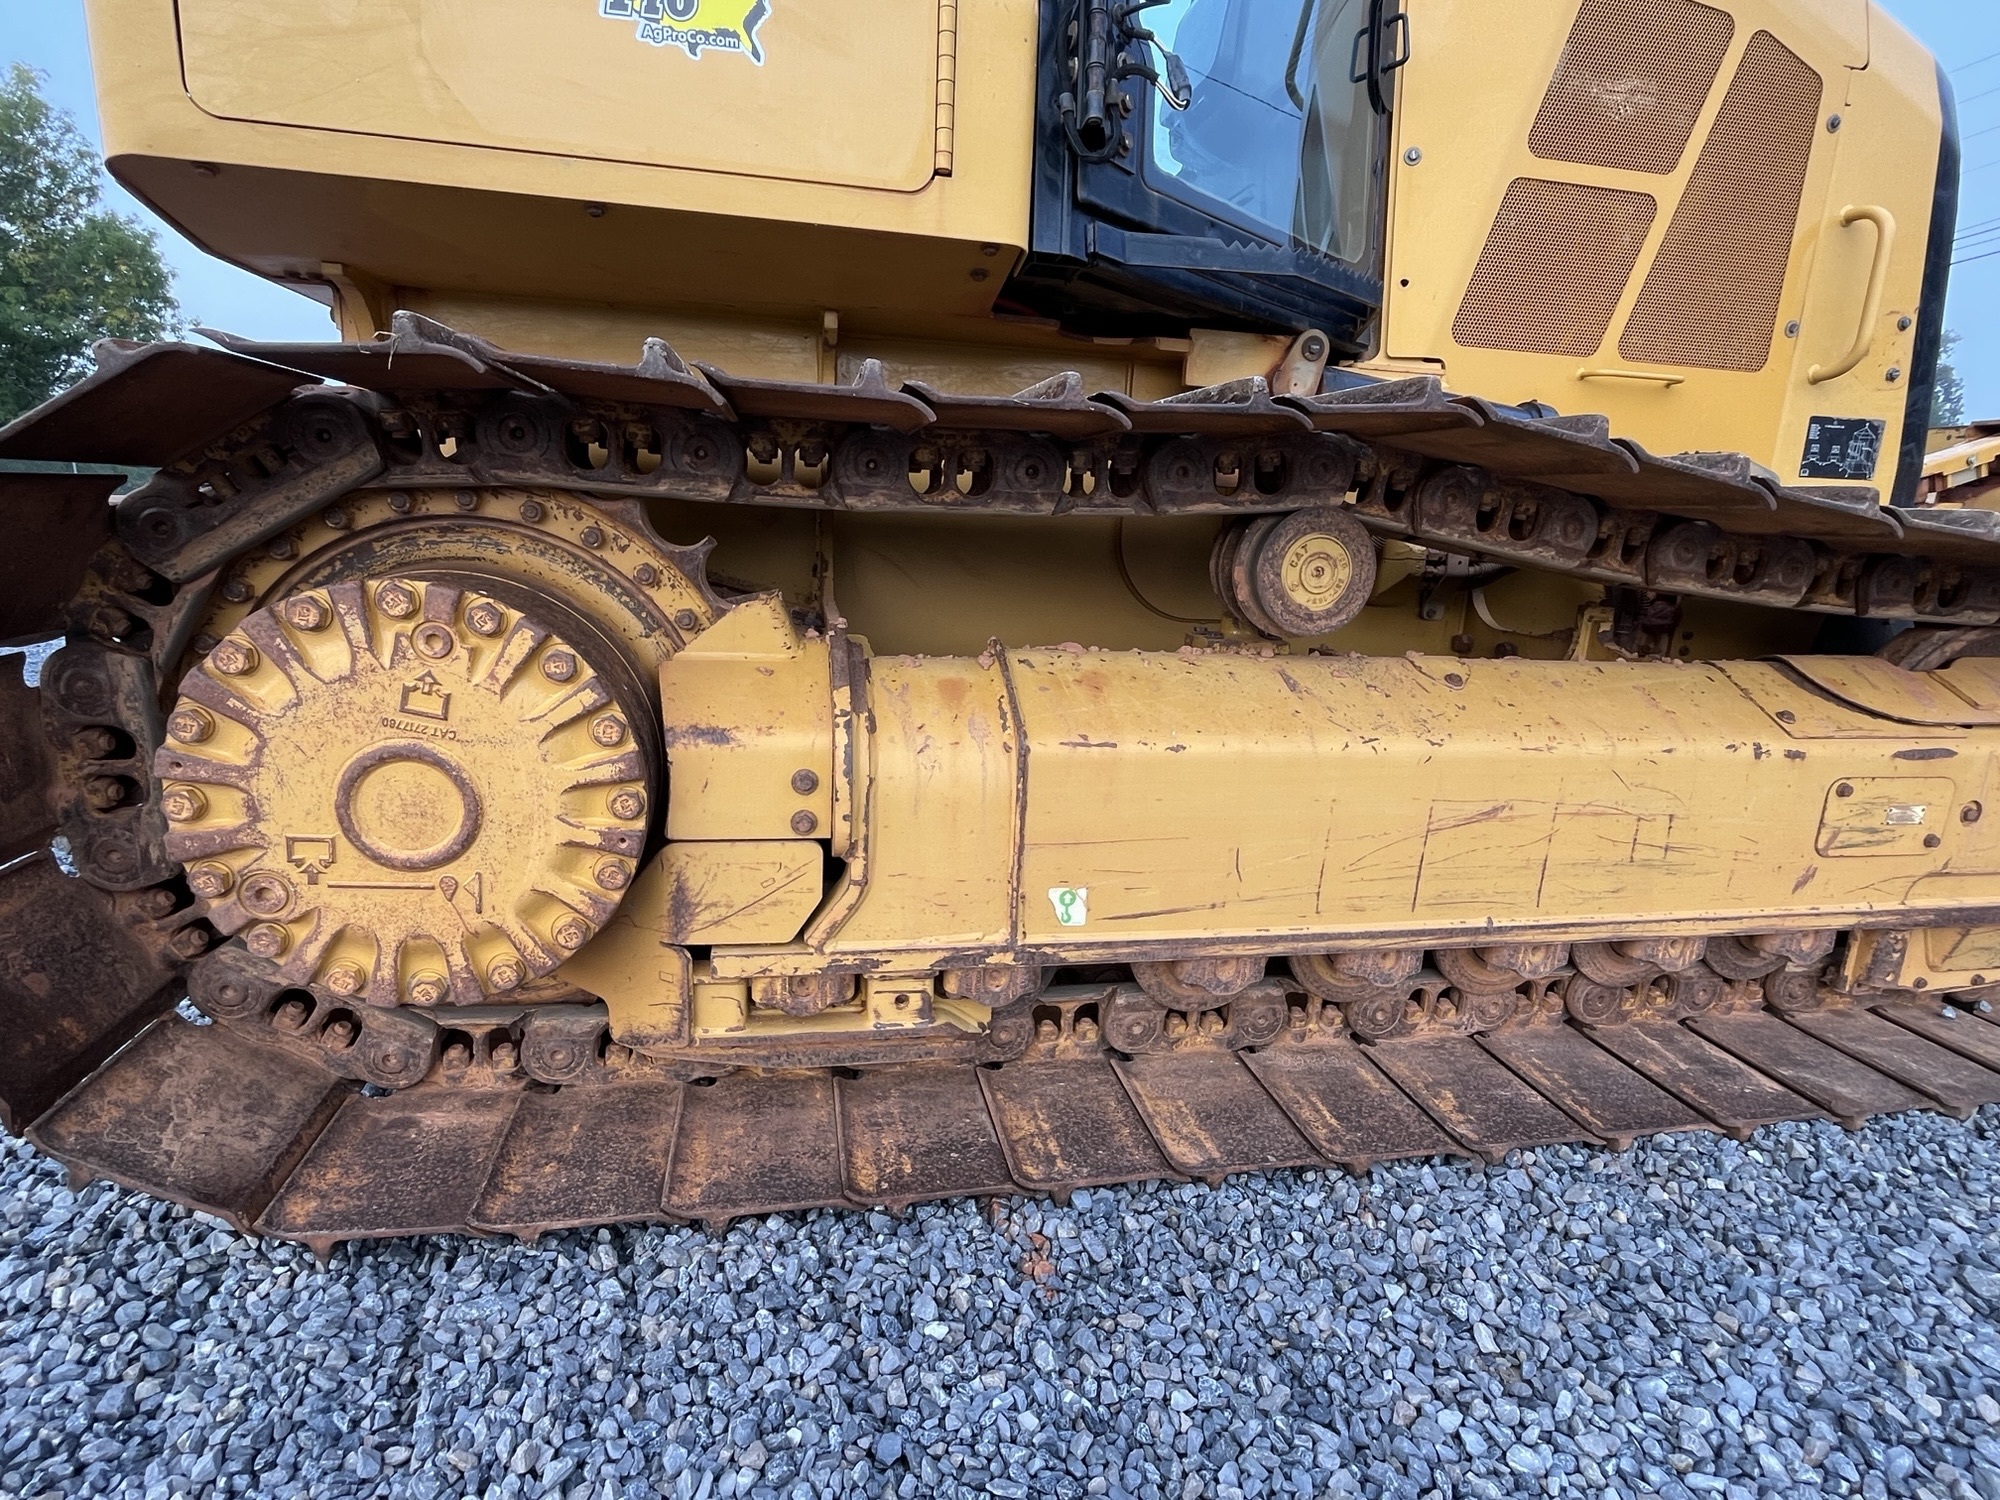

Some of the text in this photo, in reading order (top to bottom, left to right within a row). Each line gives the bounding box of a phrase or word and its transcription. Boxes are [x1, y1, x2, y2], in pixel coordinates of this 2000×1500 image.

[642, 24, 739, 48] AgProCo.com
[1289, 543, 1308, 568] CAT
[430, 727, 457, 740] CAT
